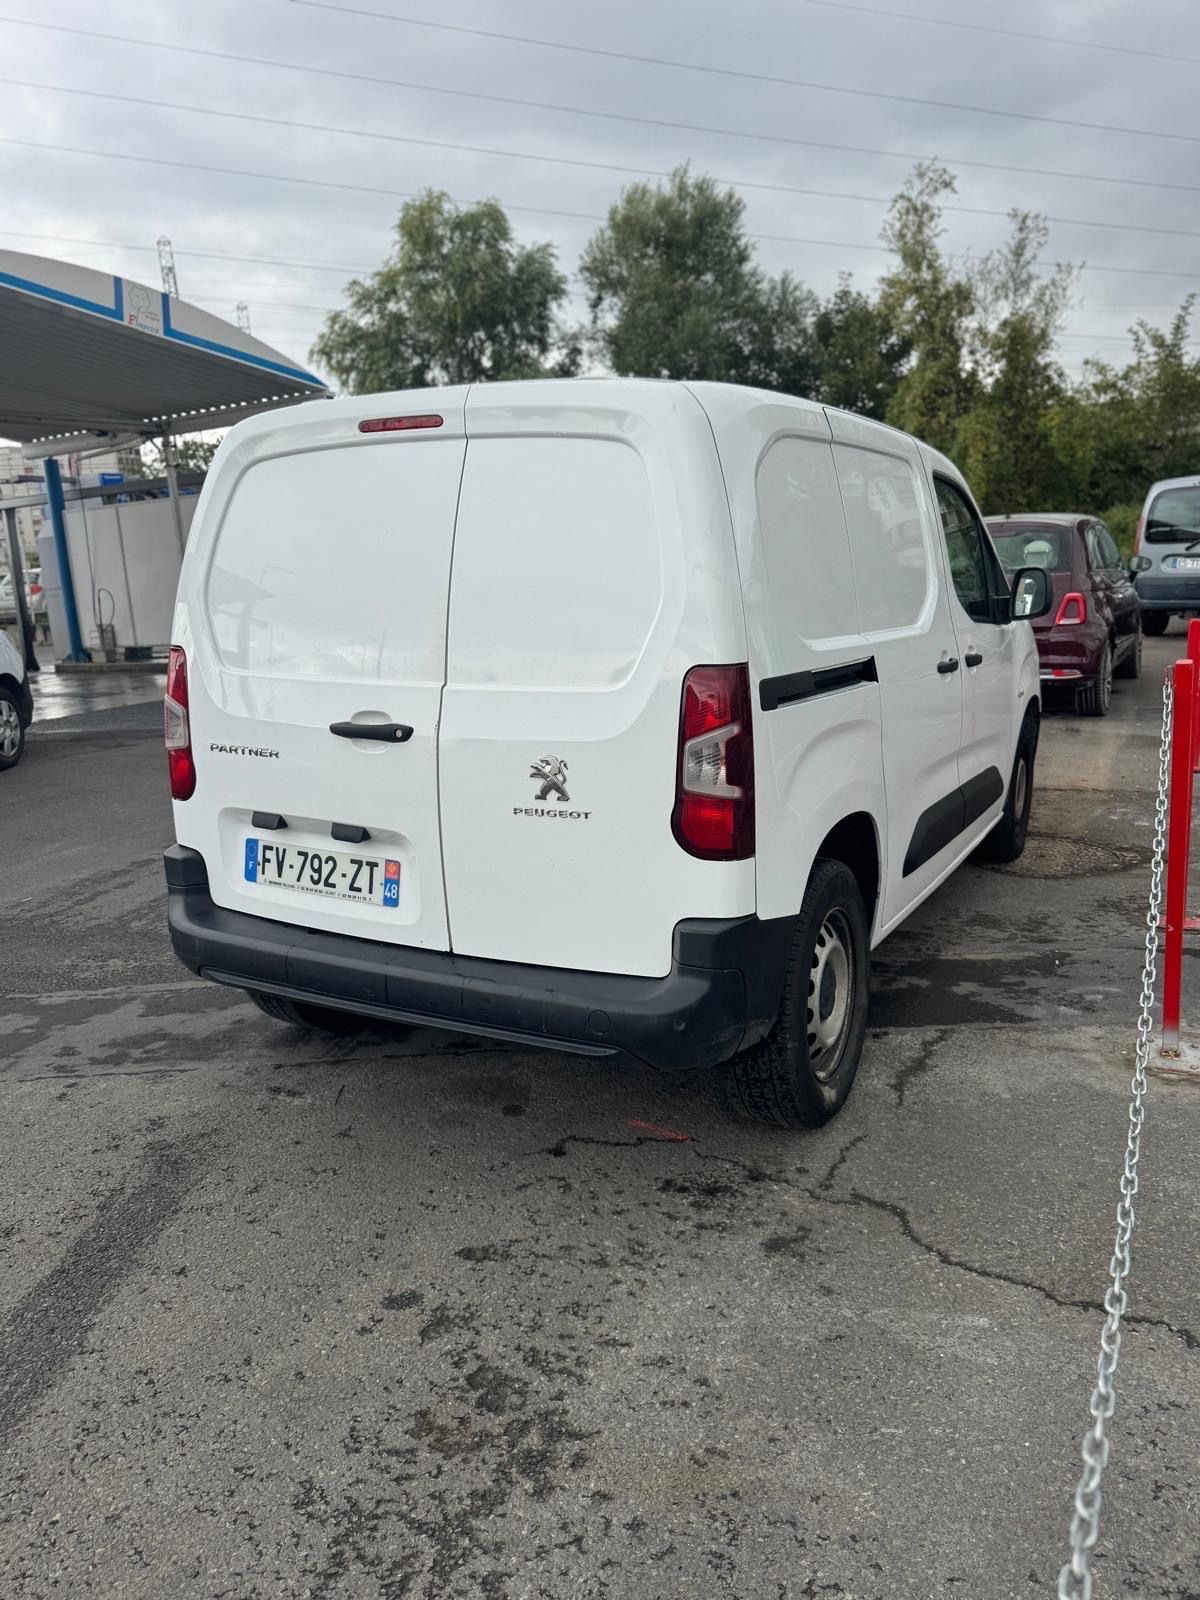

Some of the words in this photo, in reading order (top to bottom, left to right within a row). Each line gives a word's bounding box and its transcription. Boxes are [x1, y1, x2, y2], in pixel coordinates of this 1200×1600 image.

[210, 743, 280, 758] PARTNER
[513, 807, 592, 820] PEUGEOT
[249, 861, 254, 870] F
[261, 844, 379, 894] FV-792-ZT
[384, 882, 398, 899] 48
